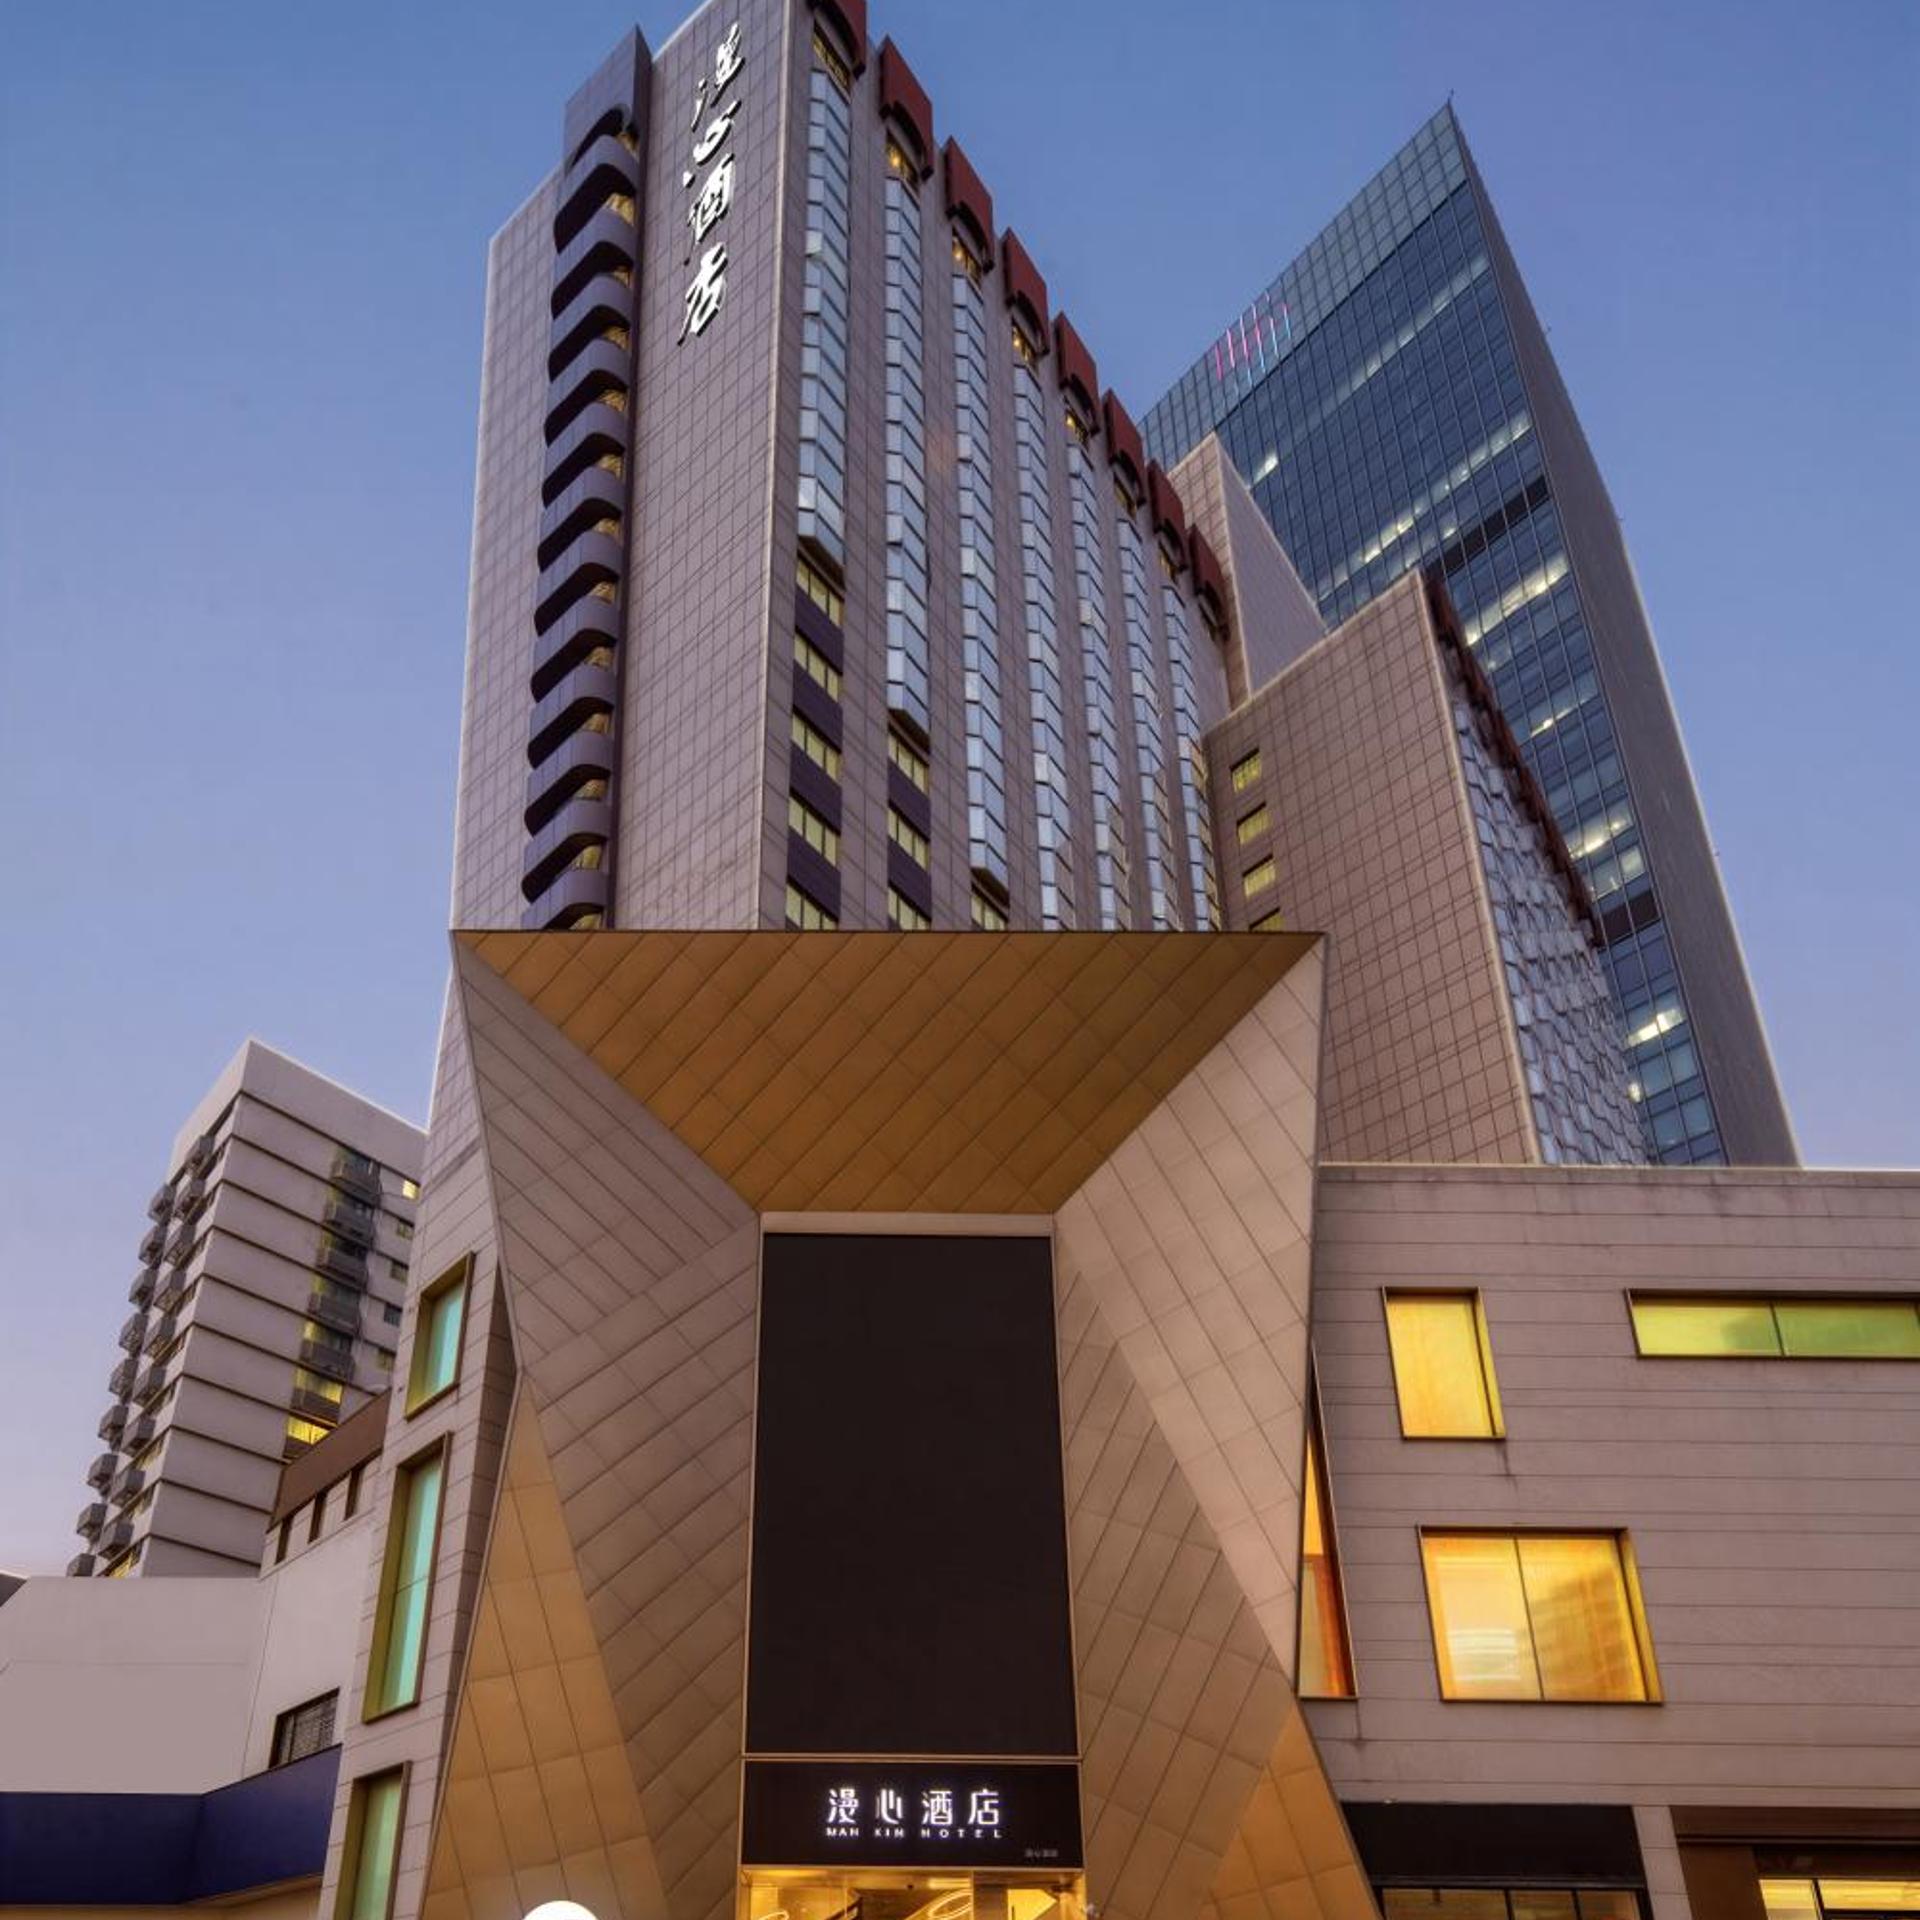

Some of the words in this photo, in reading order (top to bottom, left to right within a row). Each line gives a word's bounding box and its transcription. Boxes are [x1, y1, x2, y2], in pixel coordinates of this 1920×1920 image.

[827, 1787, 1000, 1825] 漫心酒店
[920, 1828, 1002, 1839] HOTEL
